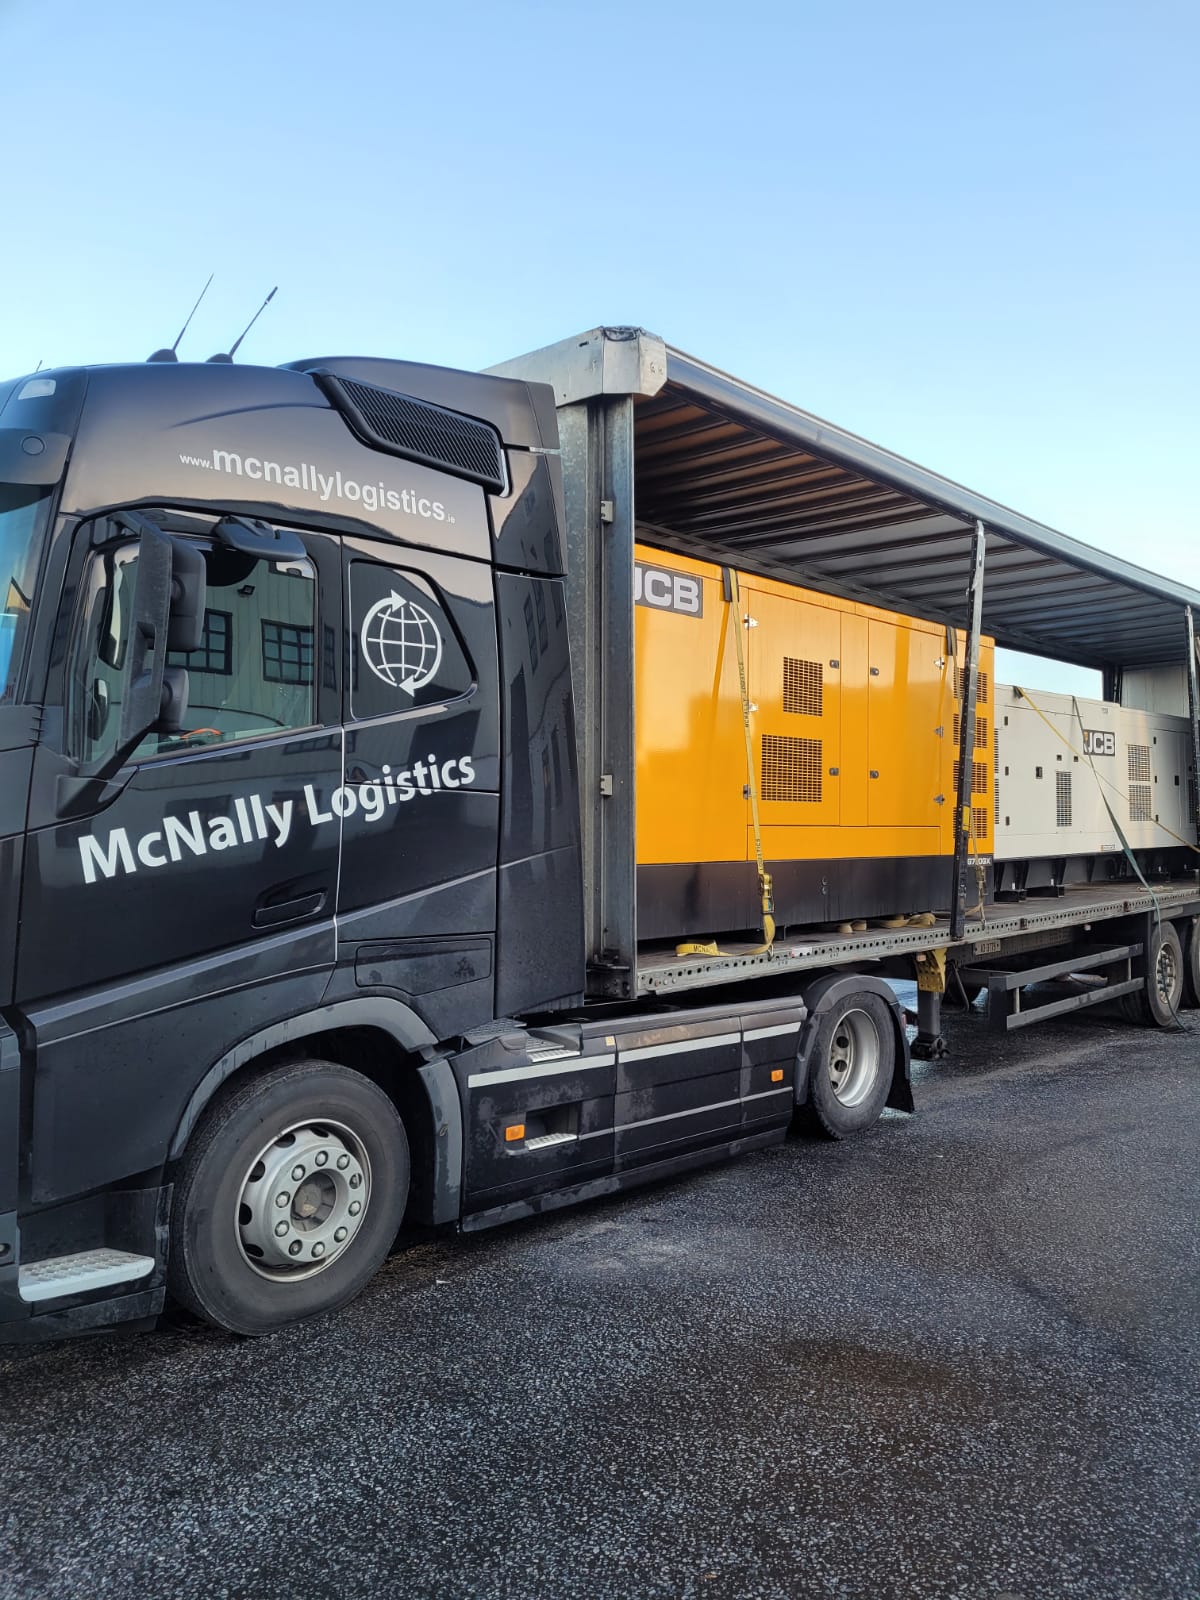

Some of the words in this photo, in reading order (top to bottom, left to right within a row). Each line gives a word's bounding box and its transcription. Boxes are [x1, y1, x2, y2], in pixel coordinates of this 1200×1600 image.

[179, 449, 456, 524] www.mcnallylogistics.ie
[1083, 731, 1115, 755] JCB
[77, 793, 293, 885] McNally
[303, 753, 476, 826] Logistics
